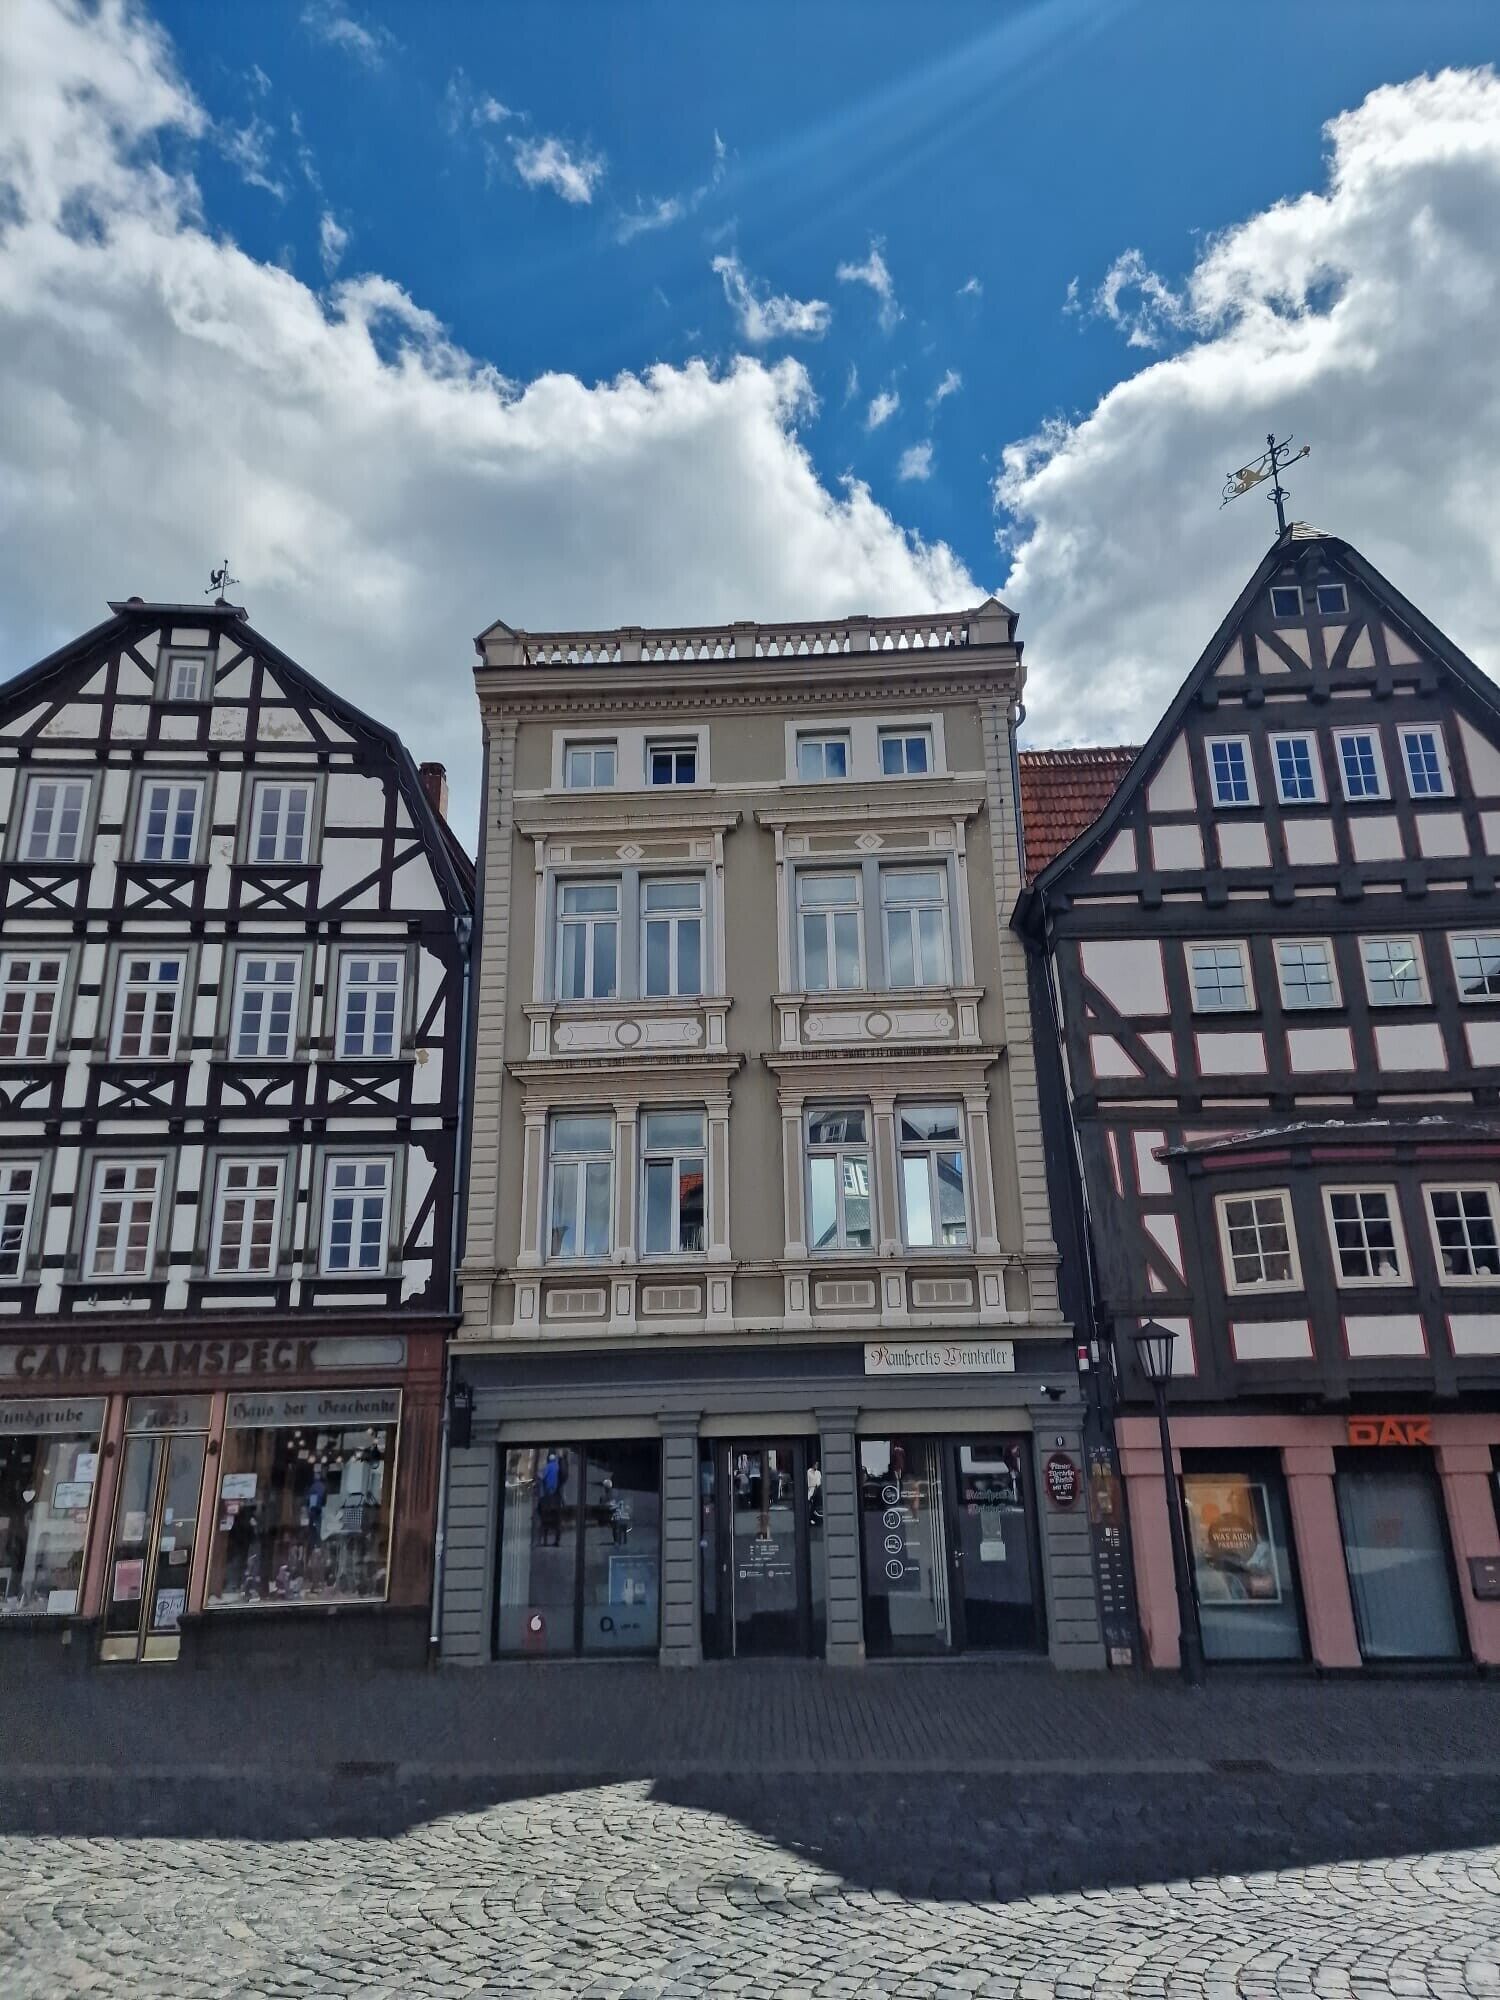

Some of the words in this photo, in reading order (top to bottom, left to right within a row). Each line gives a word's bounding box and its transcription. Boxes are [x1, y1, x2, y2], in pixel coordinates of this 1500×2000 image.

[15, 1344, 106, 1377] CARL
[120, 1339, 318, 1376] RAMSPECK
[1348, 1416, 1432, 1446] DAK
[1212, 1532, 1230, 1541] WAS
[1233, 1531, 1253, 1541] AUCH
